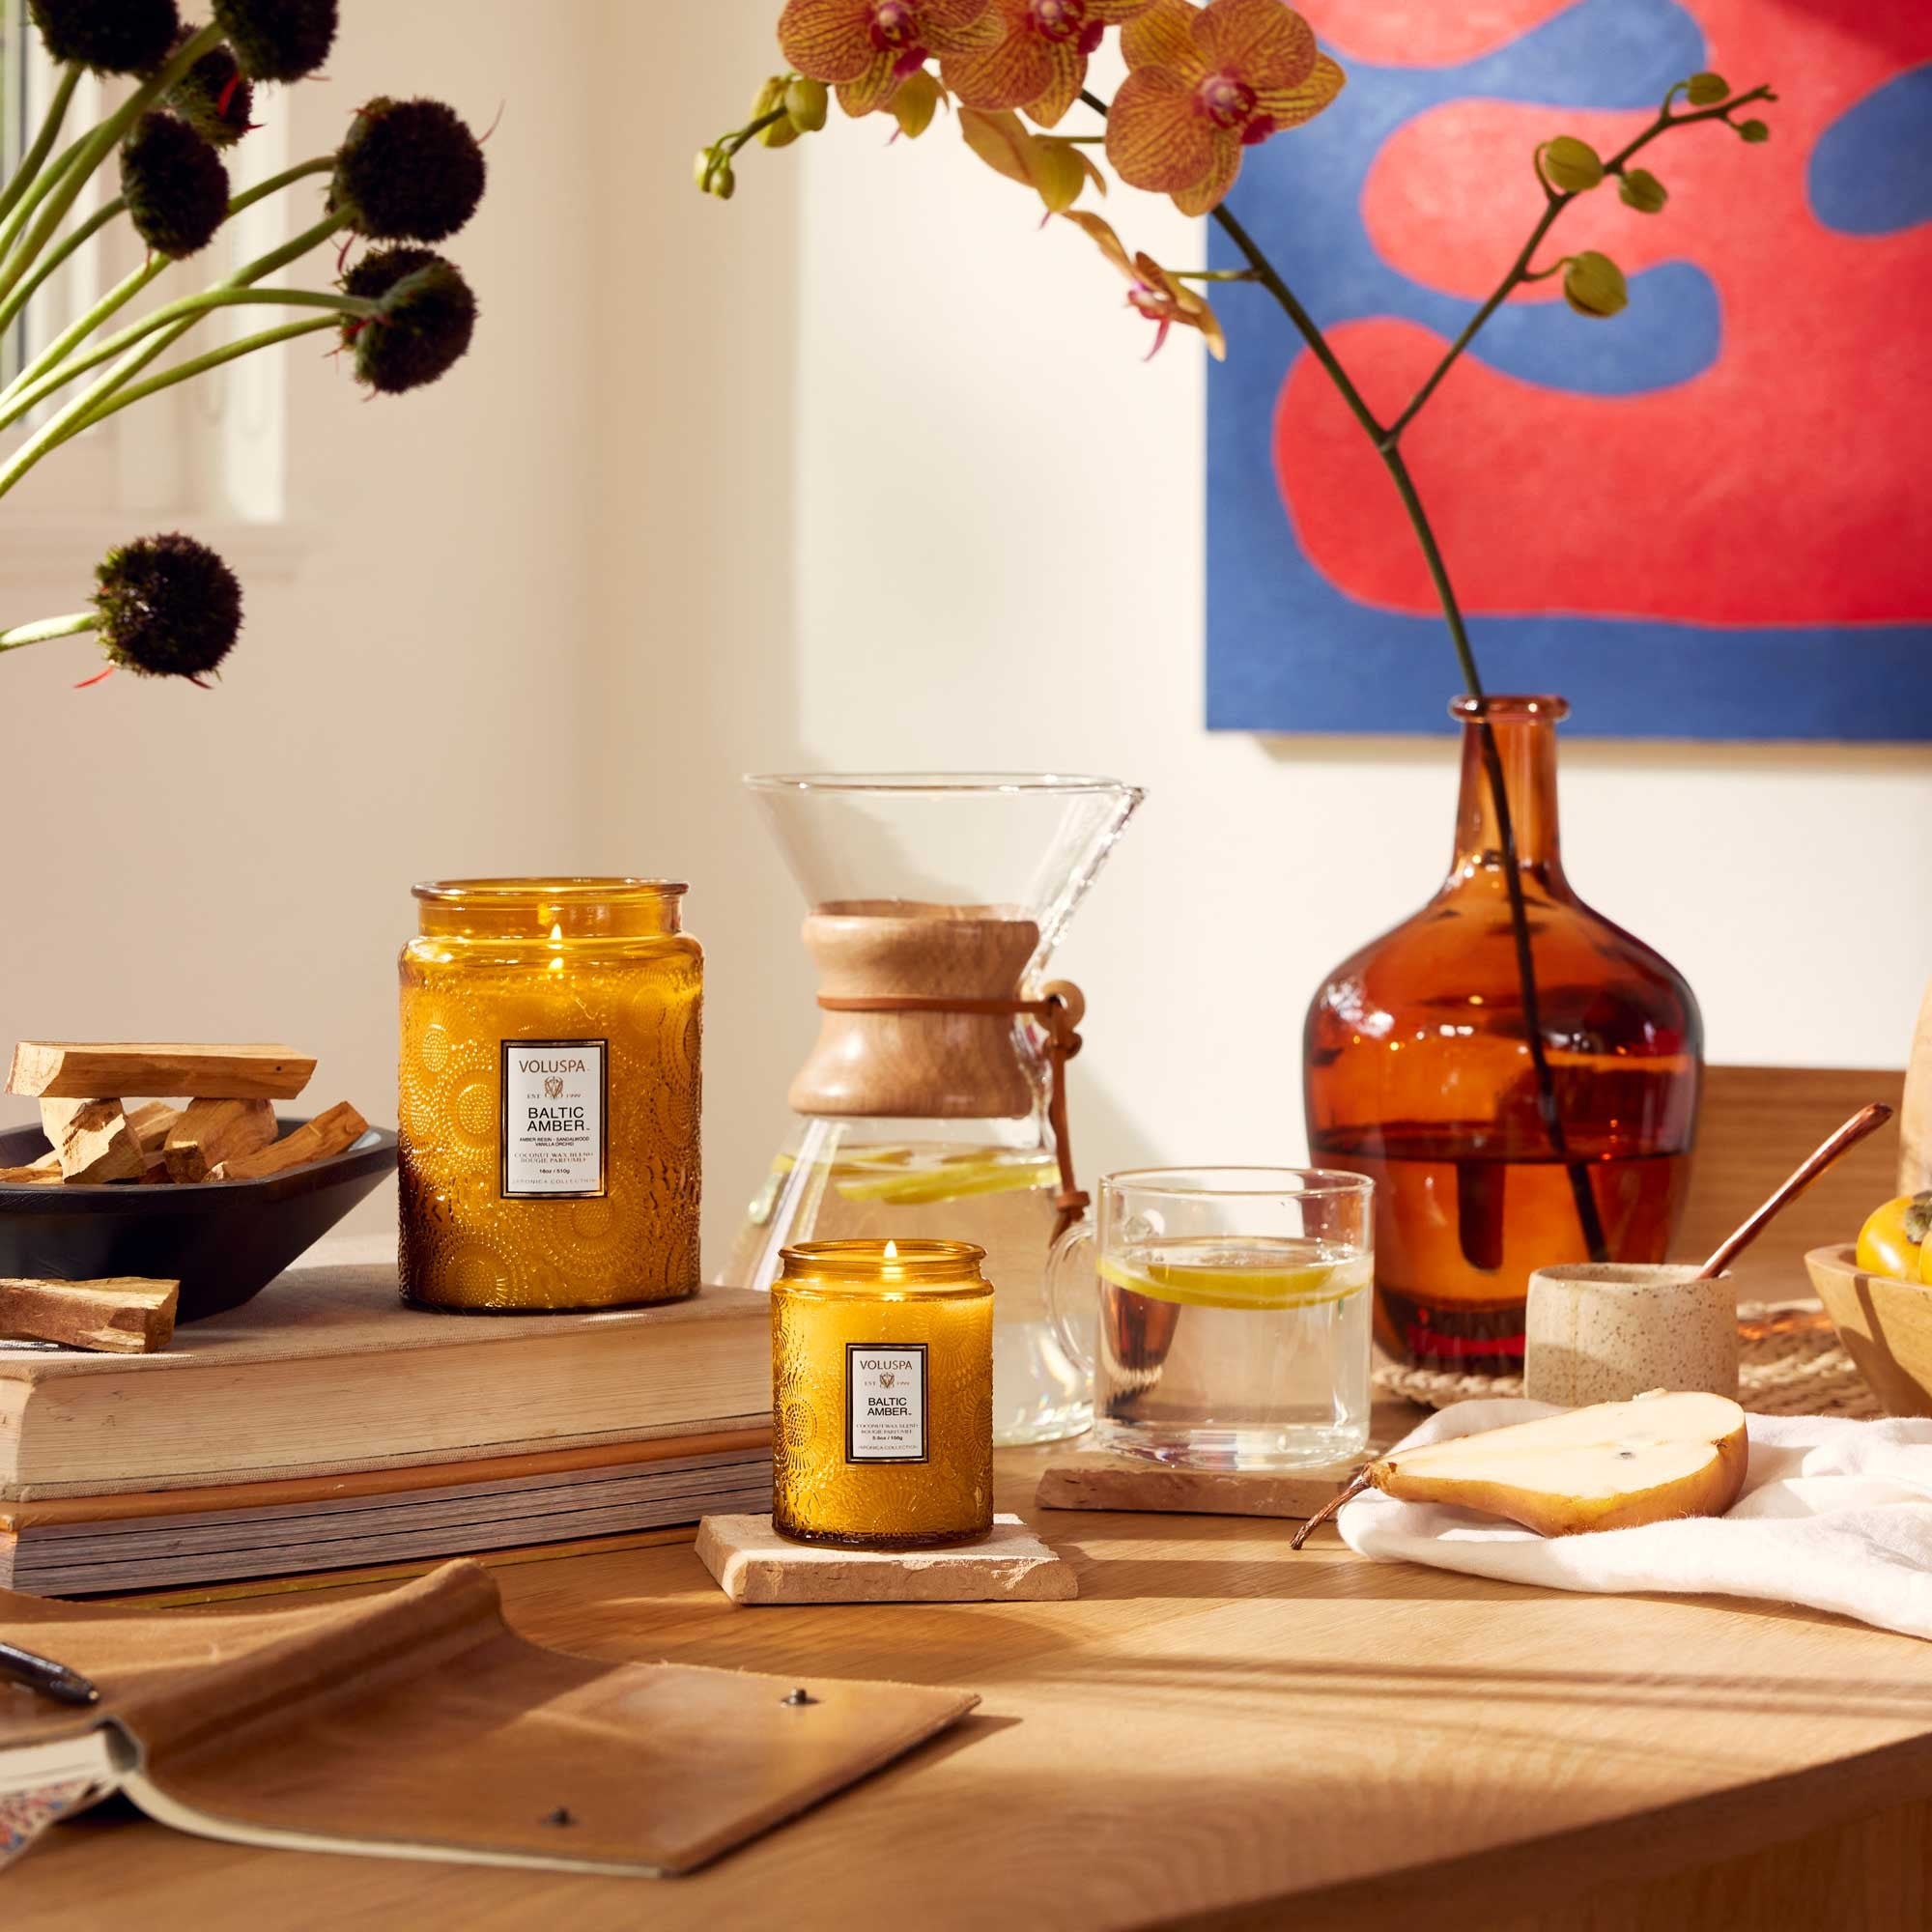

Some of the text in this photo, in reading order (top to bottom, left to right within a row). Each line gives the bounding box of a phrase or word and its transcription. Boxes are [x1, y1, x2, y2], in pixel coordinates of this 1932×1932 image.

[519, 1060, 585, 1073] VOLUSPA
[527, 1106, 584, 1119] BALTIC
[860, 1360, 913, 1370] VOLUSPA
[867, 1397, 907, 1406] BALTIC
